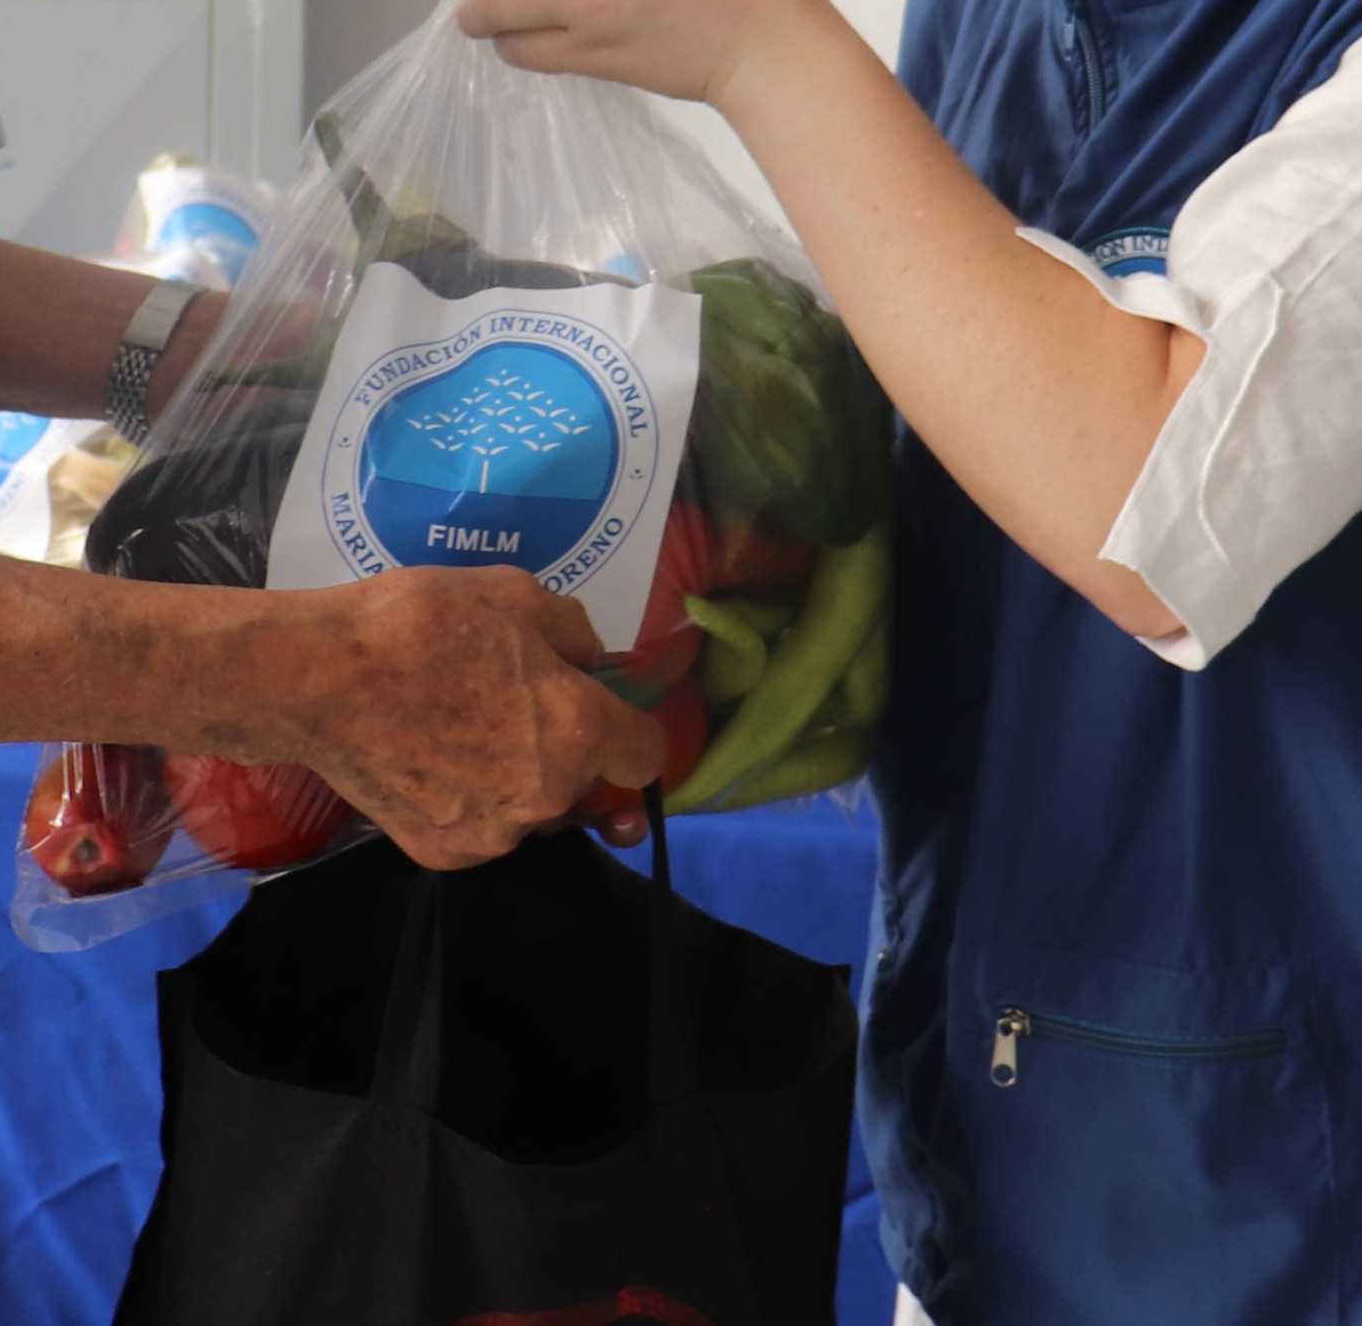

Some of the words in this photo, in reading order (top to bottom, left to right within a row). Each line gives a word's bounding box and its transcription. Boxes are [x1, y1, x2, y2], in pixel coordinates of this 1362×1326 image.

[354, 325, 482, 407] FUNDACIÓN
[488, 315, 650, 439] INTERNACIONAL
[426, 523, 521, 554] FIMLM
[542, 517, 623, 594] ORENO
